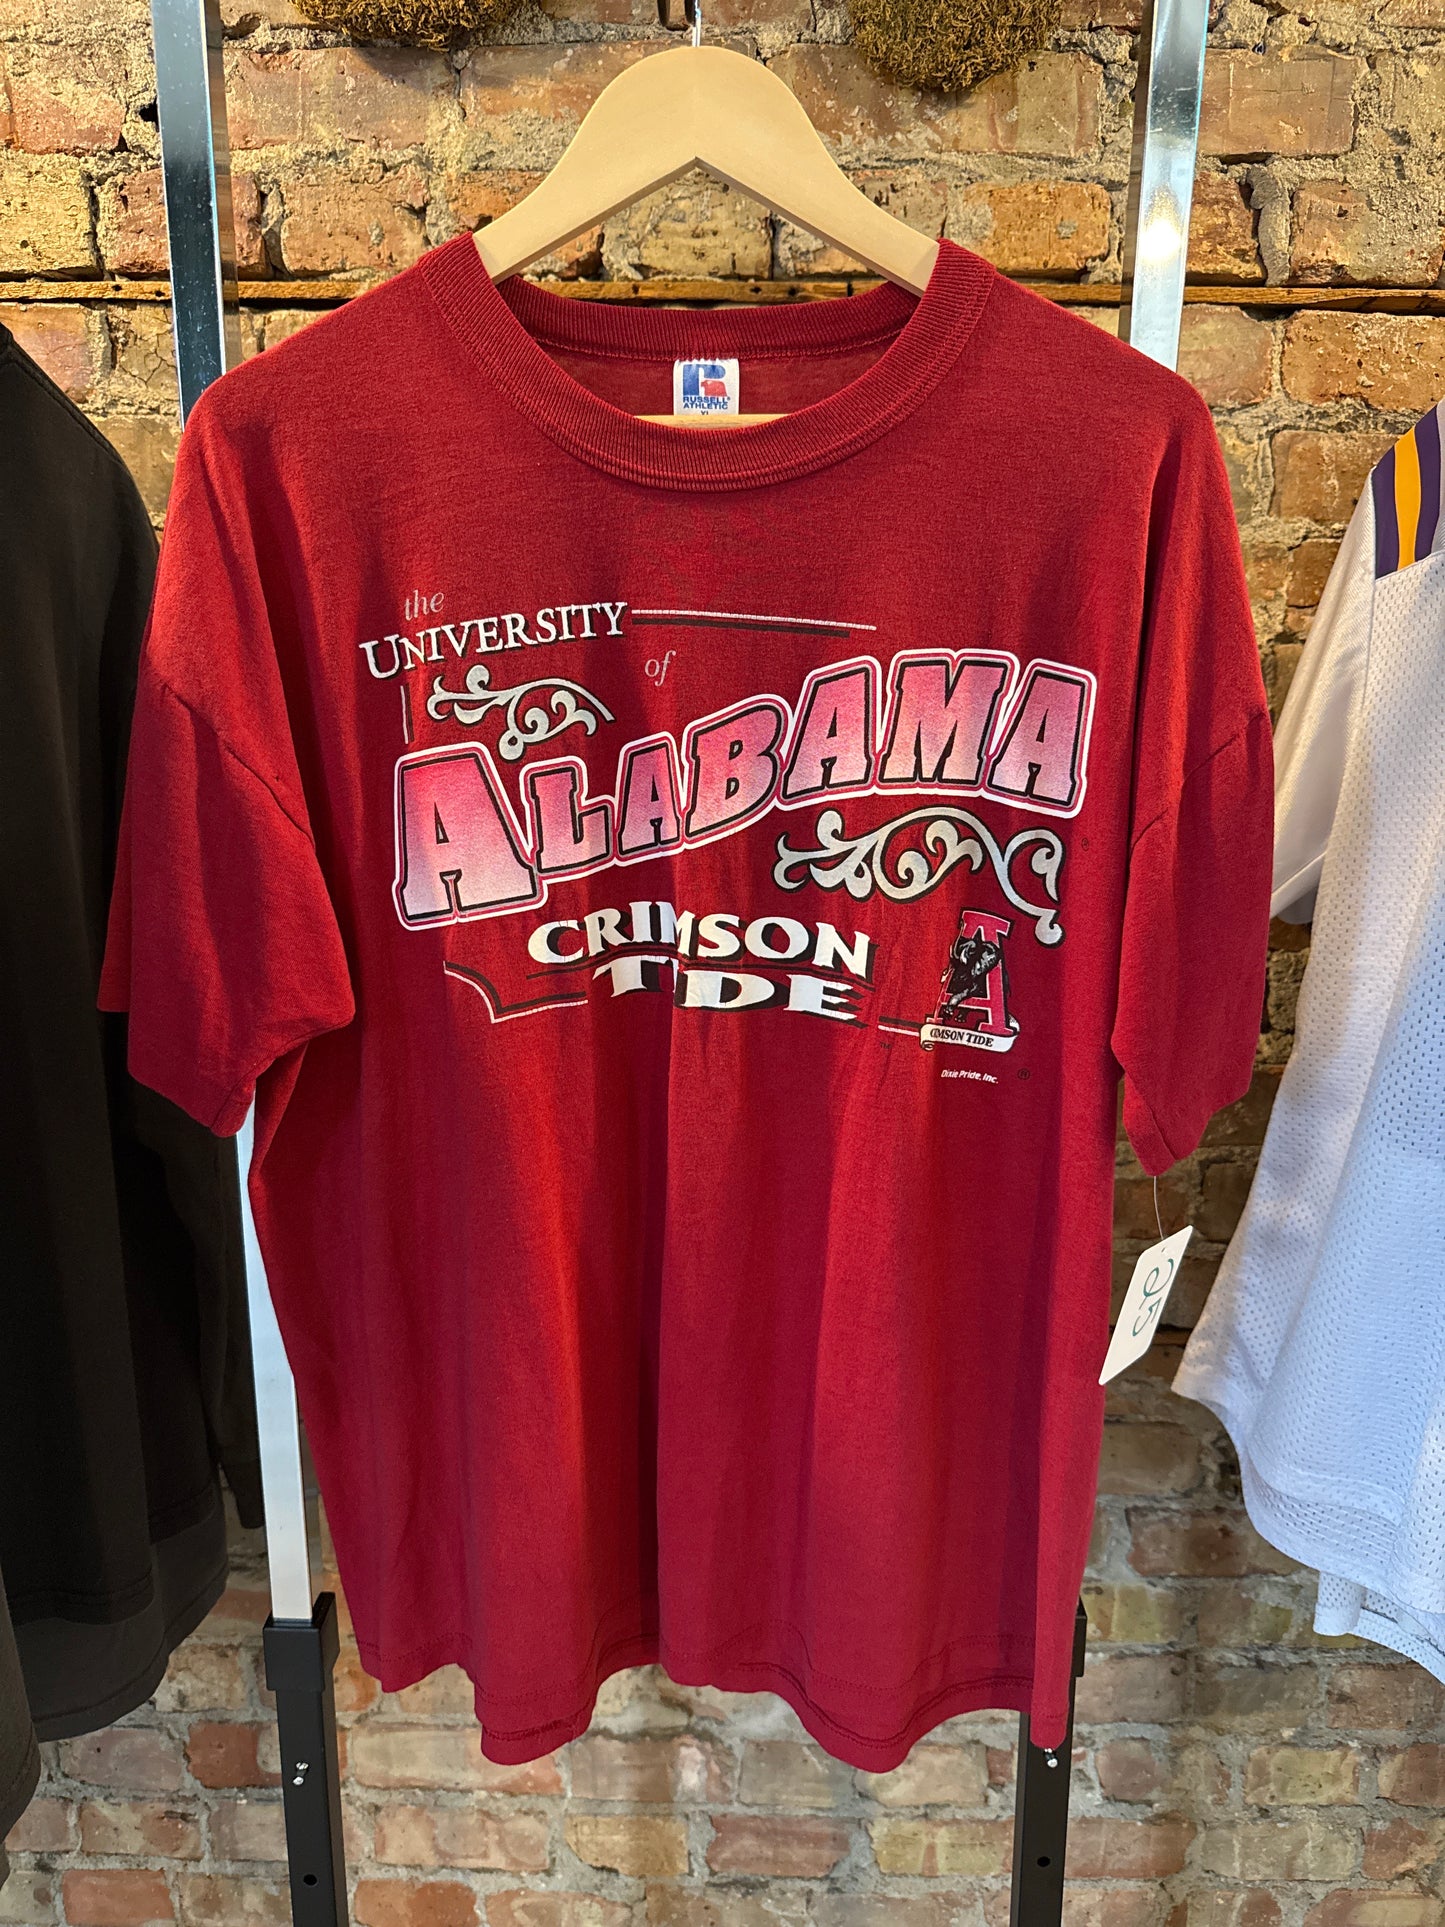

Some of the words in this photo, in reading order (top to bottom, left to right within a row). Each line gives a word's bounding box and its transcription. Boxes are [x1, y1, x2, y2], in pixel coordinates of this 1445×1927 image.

[683, 396, 727, 404] RUSSELL
[684, 402, 728, 410] ATHLETIC
[404, 590, 445, 621] the
[359, 601, 628, 679] UNIVERSITY
[645, 650, 676, 687] of
[392, 648, 1098, 931] ALABAMA
[527, 901, 871, 979] CRIMSON
[592, 955, 860, 1022] TDE
[966, 1032, 995, 1047] TIDE
[941, 1069, 958, 1078] Dixie
[983, 1073, 999, 1084] Inc.
